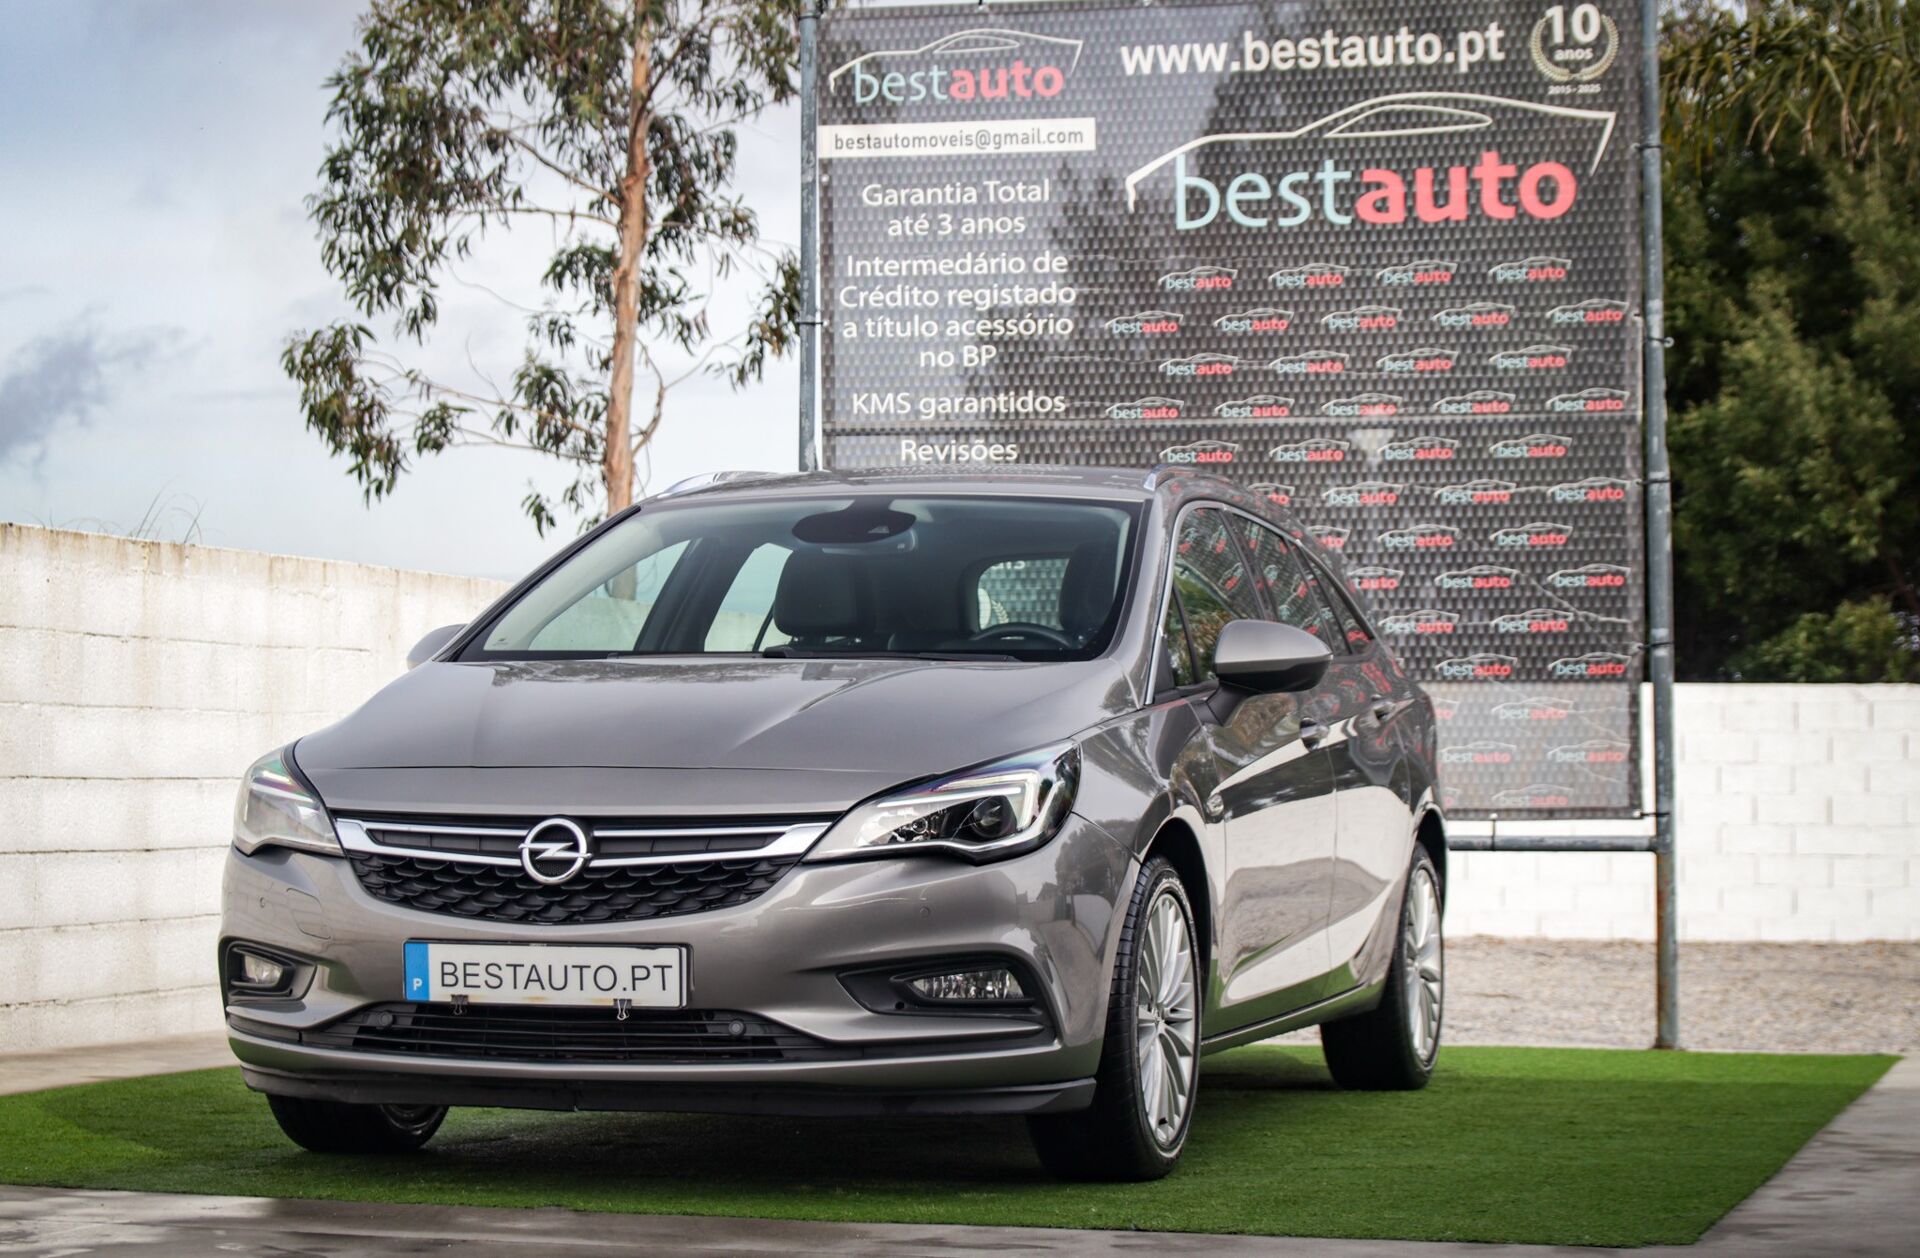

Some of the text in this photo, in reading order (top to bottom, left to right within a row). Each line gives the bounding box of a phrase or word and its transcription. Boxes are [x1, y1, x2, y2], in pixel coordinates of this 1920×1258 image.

[1545, 3, 1600, 44] 10
[1121, 22, 1505, 75] www.bestauto.pt
[1554, 48, 1594, 60] anos
[854, 60, 1065, 103] bestauto
[834, 129, 1084, 150] bestautomoveis@gmail.com
[862, 178, 1050, 207] Garantia Total
[1175, 151, 1577, 230] bestauto
[888, 212, 1026, 236] até 3 anos
[846, 250, 1069, 277] Intermedário de
[1276, 273, 1343, 287] bestauto
[1384, 270, 1451, 284] bestauto
[1497, 267, 1566, 281] bestauto
[1166, 275, 1232, 289] bestauto
[839, 281, 1077, 311] Crédito registado
[1329, 315, 1396, 330] bestauto
[1440, 312, 1509, 327] bestauto
[1554, 309, 1623, 323] bestauto
[842, 312, 1075, 339] a título acessório
[1112, 320, 1178, 334] bestauto
[1222, 318, 1288, 332] bestauto
[919, 345, 997, 369] no BP
[1384, 357, 1452, 372] bestauto
[1497, 355, 1566, 369] bestauto
[1167, 362, 1232, 376] bestauto
[1276, 359, 1344, 374] bestauto
[852, 390, 1067, 420] KMS garantidos
[1221, 404, 1288, 418] bestauto
[1329, 402, 1396, 416] bestauto
[1440, 400, 1510, 415] bestauto
[1554, 397, 1624, 412] bestauto
[1113, 406, 1178, 420] bestauto
[900, 439, 1019, 463] Revisões
[1168, 450, 1233, 464] bestauto
[1277, 449, 1343, 463] bestauto
[1384, 446, 1453, 461] bestauto
[1497, 444, 1566, 459] bestauto
[1329, 490, 1397, 505] bestauto
[1441, 488, 1510, 503] bestauto
[1555, 486, 1624, 501] bestauto
[1385, 534, 1453, 548] bestauto
[1498, 531, 1567, 546] bestauto
[1354, 577, 1399, 591] tauto
[1443, 575, 1511, 589] bestauto
[1556, 573, 1624, 588] bestauto
[1385, 620, 1453, 634] bestauto
[1499, 618, 1567, 633] bestauto
[1443, 663, 1511, 677] bestauto
[1556, 661, 1625, 676] bestauto
[412, 961, 673, 992] P BESTAUTO.PT
